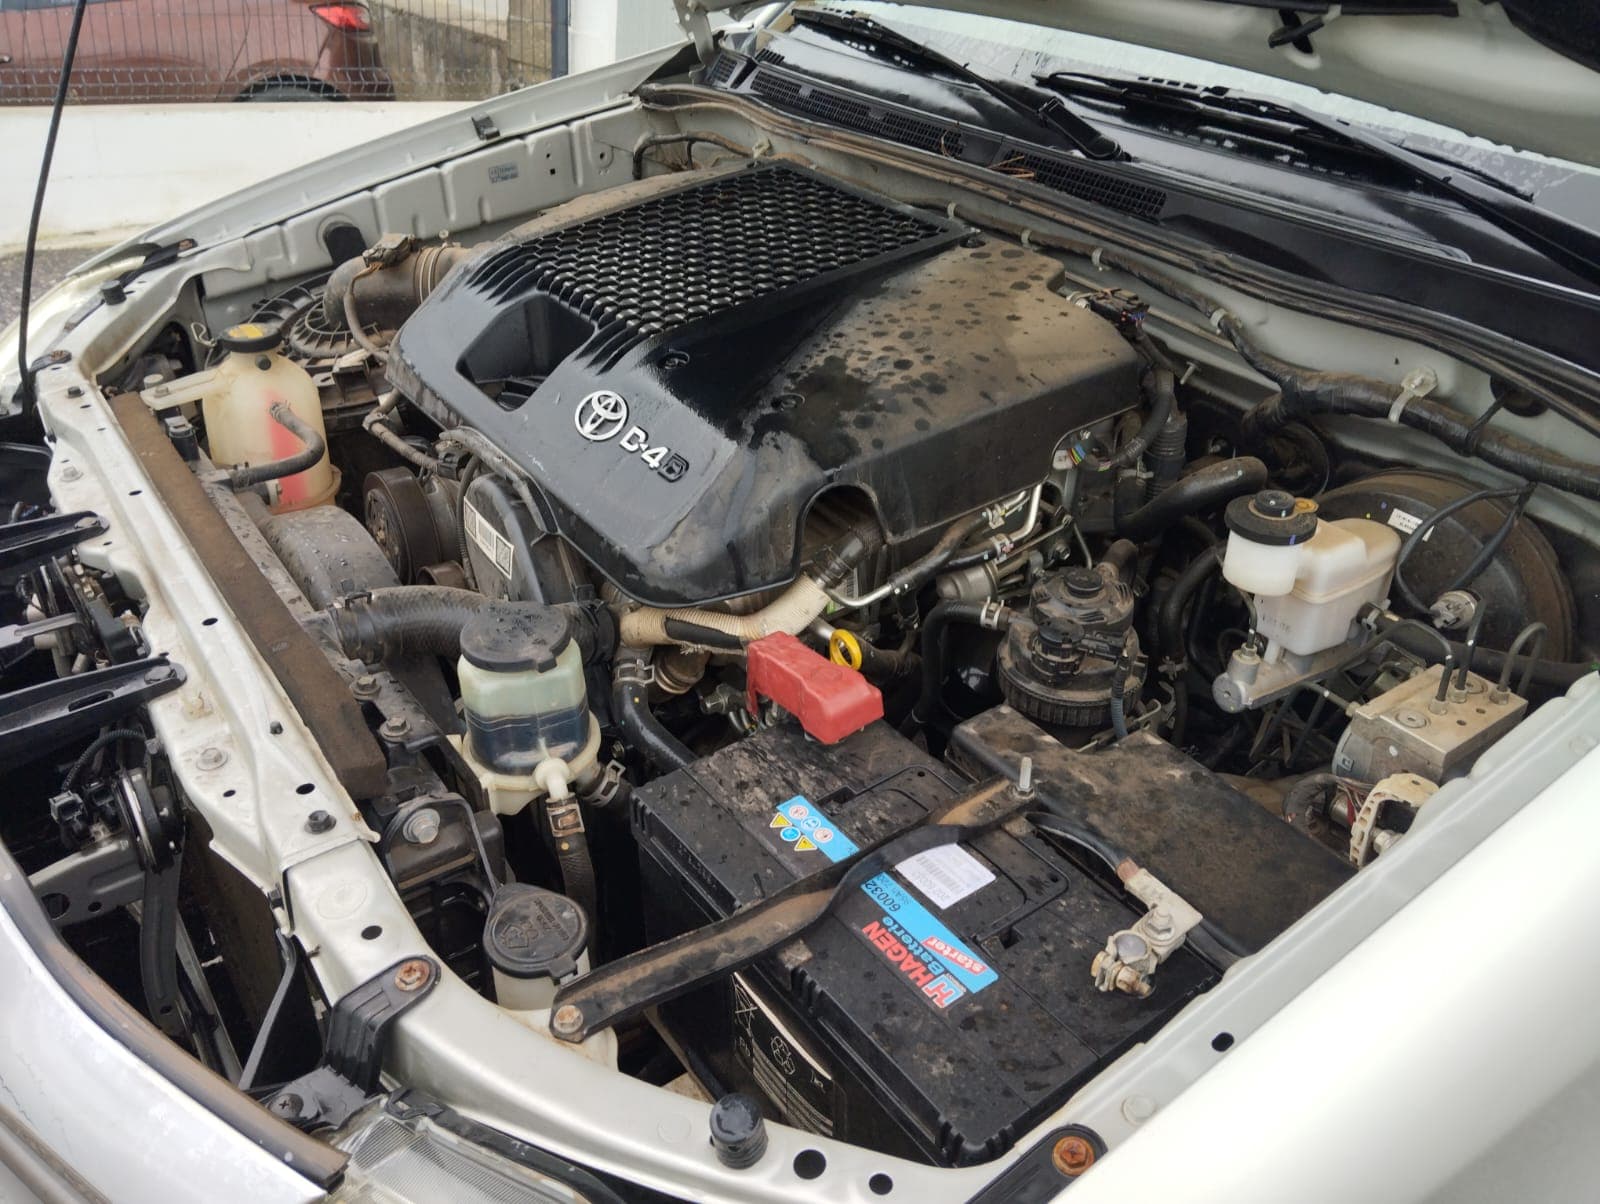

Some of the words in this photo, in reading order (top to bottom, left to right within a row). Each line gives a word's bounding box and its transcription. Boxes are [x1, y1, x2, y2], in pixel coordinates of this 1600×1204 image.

[865, 880, 900, 912] 60032
[861, 920, 935, 988] HAGEN
[927, 937, 984, 973] starter
